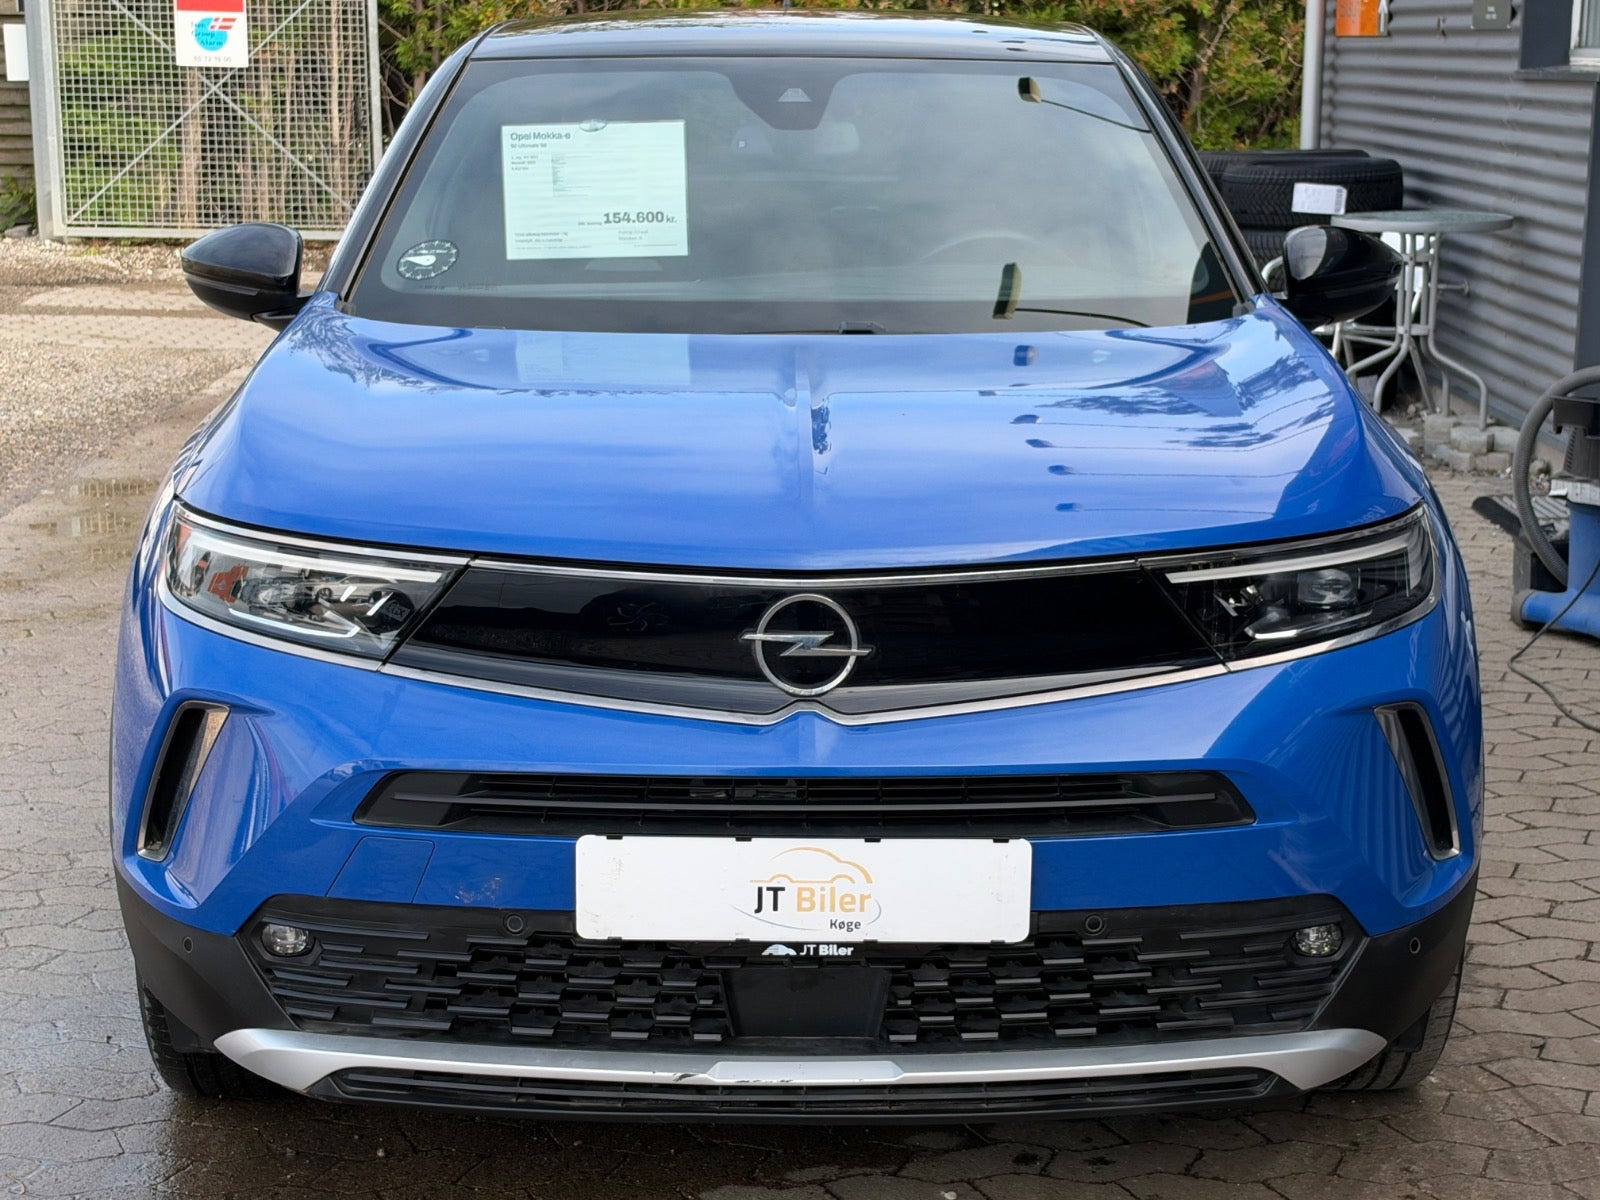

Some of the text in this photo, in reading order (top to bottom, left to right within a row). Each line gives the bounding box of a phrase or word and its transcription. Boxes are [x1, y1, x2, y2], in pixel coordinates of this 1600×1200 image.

[510, 131, 571, 142] Opel Mokka-e
[603, 211, 665, 224] 154.600
[665, 213, 678, 223] kr.
[754, 886, 872, 914] JT Biler
[829, 918, 862, 932] Køge
[799, 944, 854, 956] JT Biler
